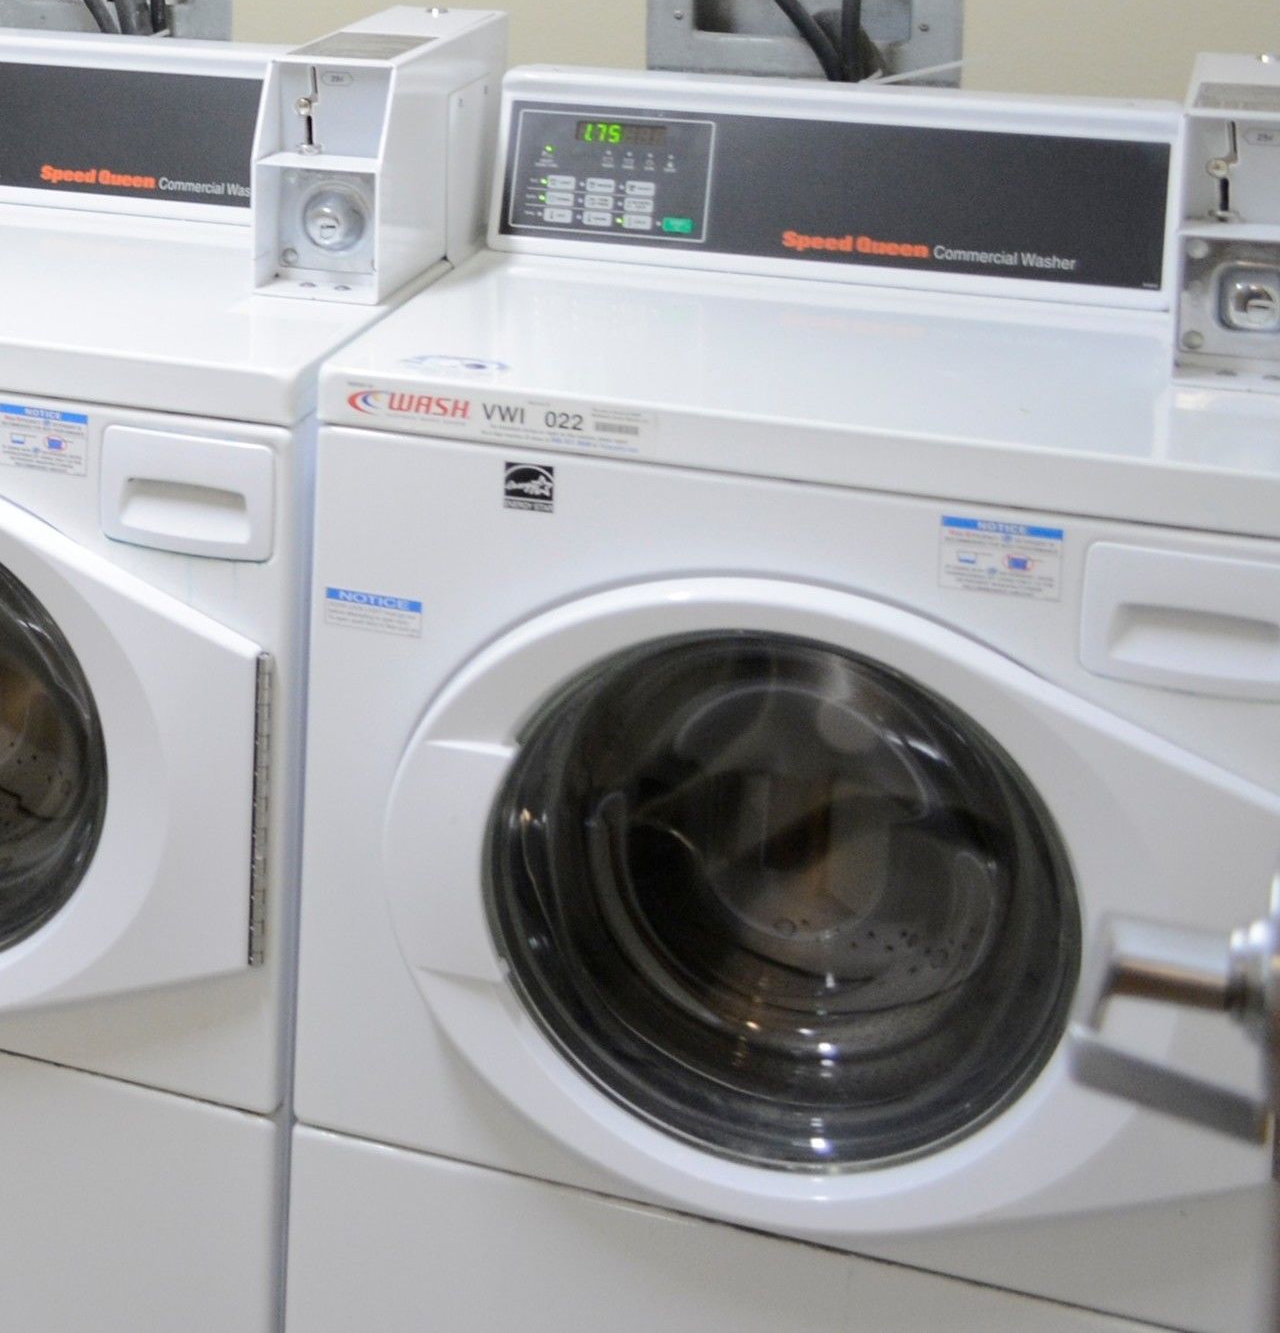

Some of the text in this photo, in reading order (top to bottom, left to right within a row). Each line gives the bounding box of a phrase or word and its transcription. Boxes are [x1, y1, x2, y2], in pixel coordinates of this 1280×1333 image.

[41, 165, 96, 184] Speed
[98, 169, 156, 189] Queen
[158, 177, 225, 195] Commercial
[782, 230, 1076, 270] Speed Queen Commercial Washer
[389, 392, 584, 431] WASH VWI 022
[338, 590, 410, 611] NOTICE
